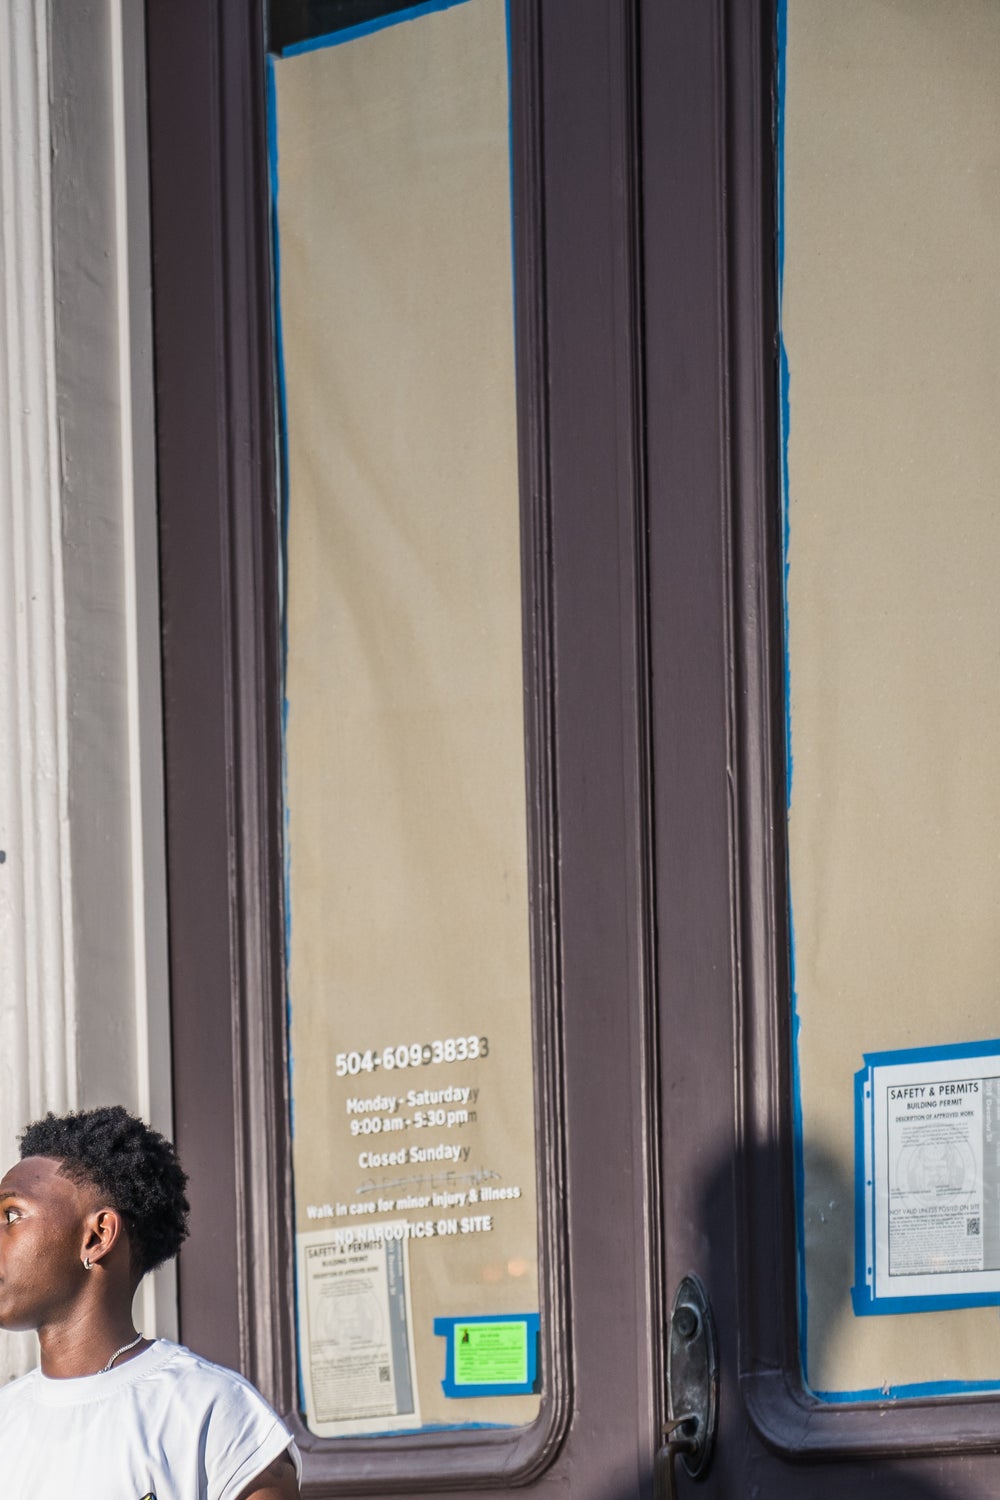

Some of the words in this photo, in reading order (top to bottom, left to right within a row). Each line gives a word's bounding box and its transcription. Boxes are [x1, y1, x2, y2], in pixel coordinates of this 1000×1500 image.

[336, 1036, 480, 1076] 504-609-3833
[346, 1096, 397, 1114] Monday
[407, 1085, 470, 1107] Saturday
[890, 1087, 925, 1100] SAFETY
[929, 1087, 935, 1097] &
[939, 1082, 979, 1096] PERMITS
[895, 1114, 925, 1122] DESCRIPTION
[934, 1111, 959, 1119] APPROVED
[907, 1100, 937, 1110] BUILDING
[939, 1098, 963, 1108] PERMIT
[351, 1116, 382, 1135] 9:00
[382, 1117, 403, 1131] am
[414, 1109, 445, 1128] 5:30
[446, 1109, 468, 1128] pm
[358, 1148, 406, 1168] Closed
[410, 1144, 461, 1162] Sunday
[306, 1204, 334, 1219] Walk
[335, 1202, 347, 1216] in
[349, 1202, 376, 1215] care
[377, 1198, 394, 1212] for
[396, 1194, 430, 1210] minor
[432, 1191, 466, 1208] injury
[469, 1188, 478, 1203] &
[480, 1187, 521, 1201] illness
[336, 1229, 355, 1246] NO
[358, 1221, 437, 1242] NARCOTICS
[438, 1219, 458, 1235] ON
[460, 1215, 492, 1233] SITE
[308, 1246, 337, 1259] SAFETY
[348, 1240, 382, 1253] PERMITS
